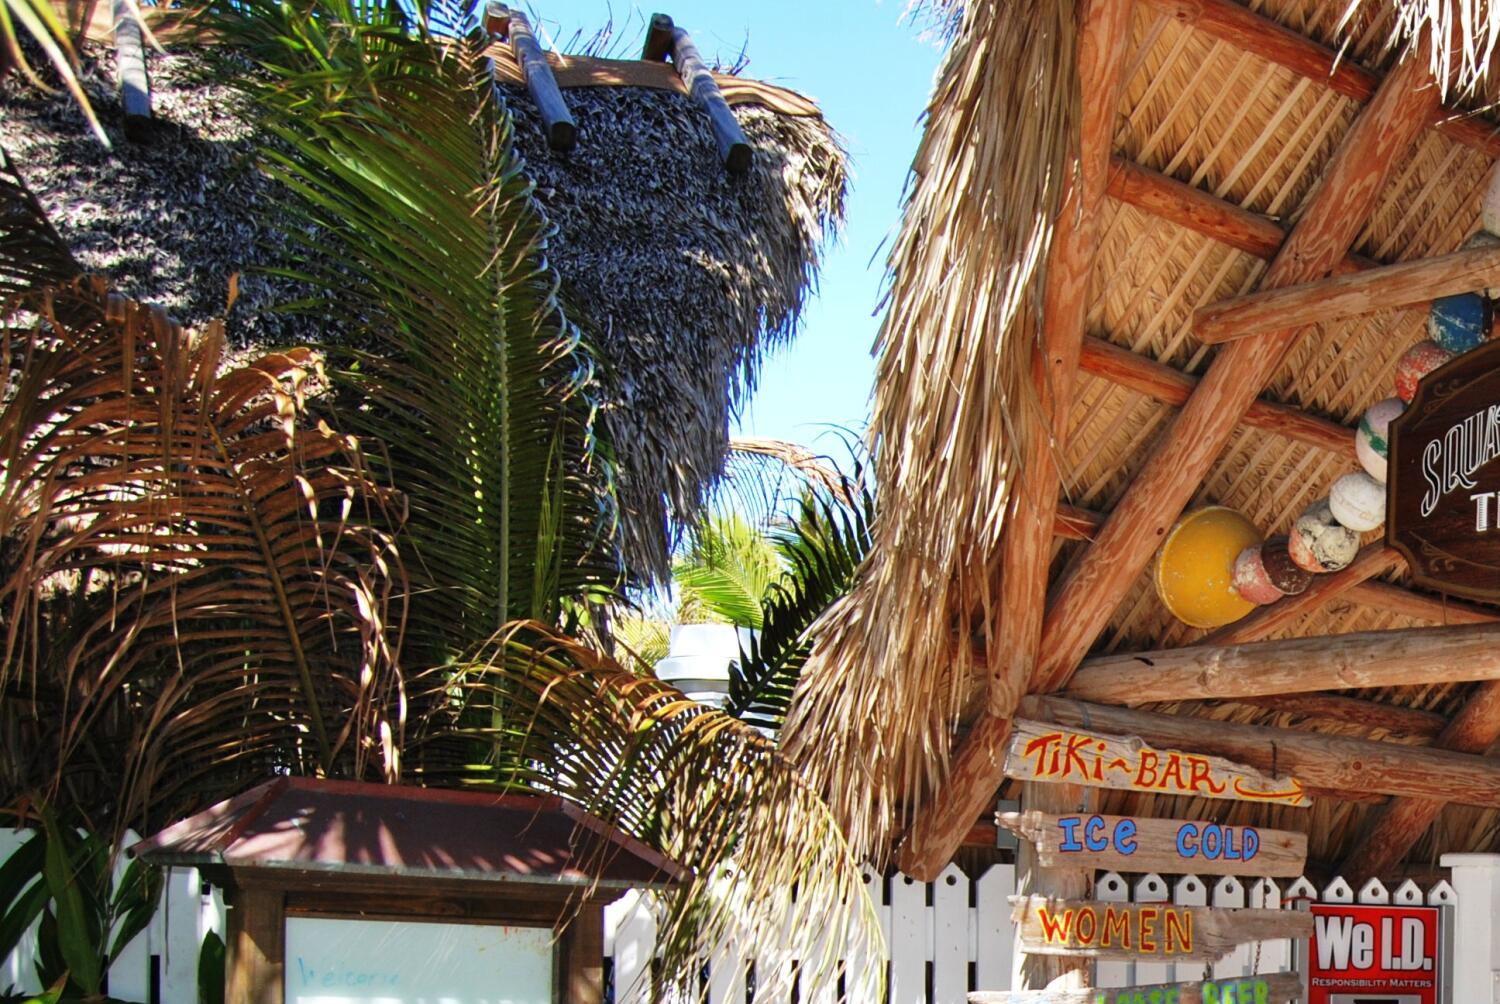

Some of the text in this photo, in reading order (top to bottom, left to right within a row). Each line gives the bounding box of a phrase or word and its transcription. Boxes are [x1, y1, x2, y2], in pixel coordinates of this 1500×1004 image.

[1176, 823, 1260, 862] COLD
[1037, 905, 1194, 954] WOMEN
[1315, 916, 1432, 970] We I.D.
